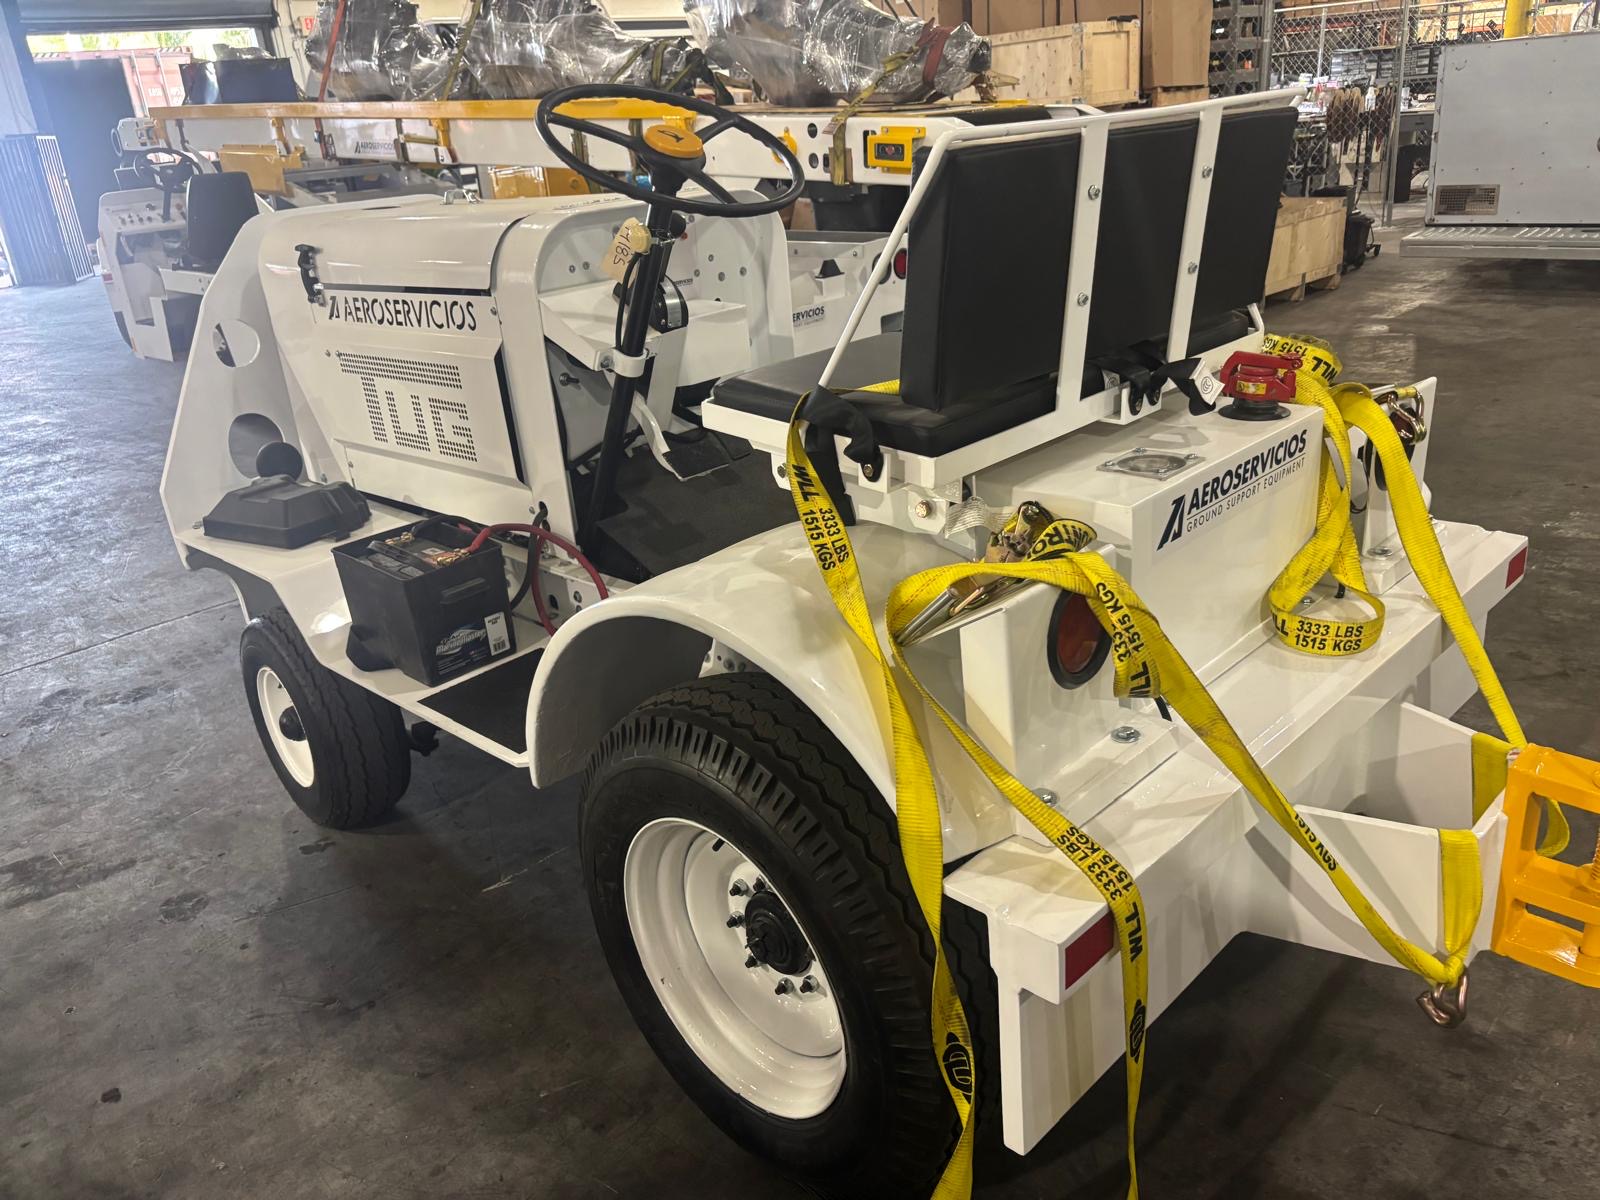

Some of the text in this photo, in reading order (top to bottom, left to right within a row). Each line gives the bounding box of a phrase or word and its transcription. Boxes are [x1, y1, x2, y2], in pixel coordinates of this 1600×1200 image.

[344, 296, 477, 331] AEROSERVICIOS
[338, 352, 478, 463] TUG
[792, 463, 820, 502] WLL
[1186, 428, 1307, 516] AEROSERVICIOS
[1186, 457, 1306, 533] GROUND SUPPORT EQUIPMENT
[802, 509, 836, 571] 1515 KGS
[819, 507, 849, 563] 3333 LBS
[1111, 624, 1131, 663] 333
[1128, 614, 1145, 653] 1515
[1295, 633, 1362, 652] 1515 KGS
[1296, 620, 1364, 638] 3333 LBS
[1056, 834, 1123, 901] 3333 LBS
[1066, 825, 1134, 893] 1515 KGS
[1124, 901, 1144, 963] WLL
